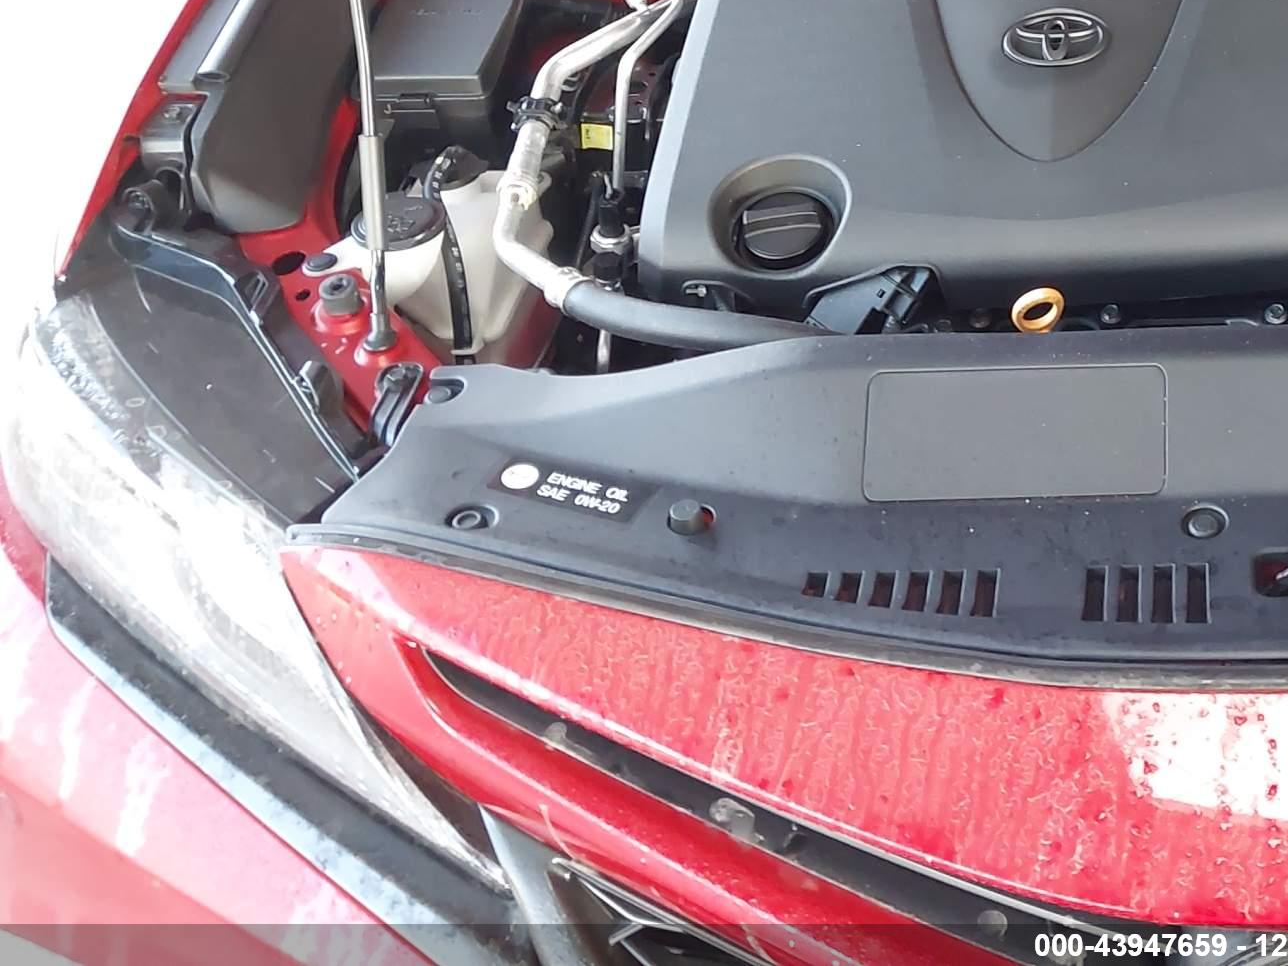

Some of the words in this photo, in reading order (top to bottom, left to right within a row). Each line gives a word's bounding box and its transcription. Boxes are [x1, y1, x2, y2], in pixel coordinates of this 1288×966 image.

[536, 484, 571, 501] SAE
[574, 495, 622, 514] 0W-20
[546, 472, 603, 494] ENGINE
[605, 486, 630, 502] OIL
